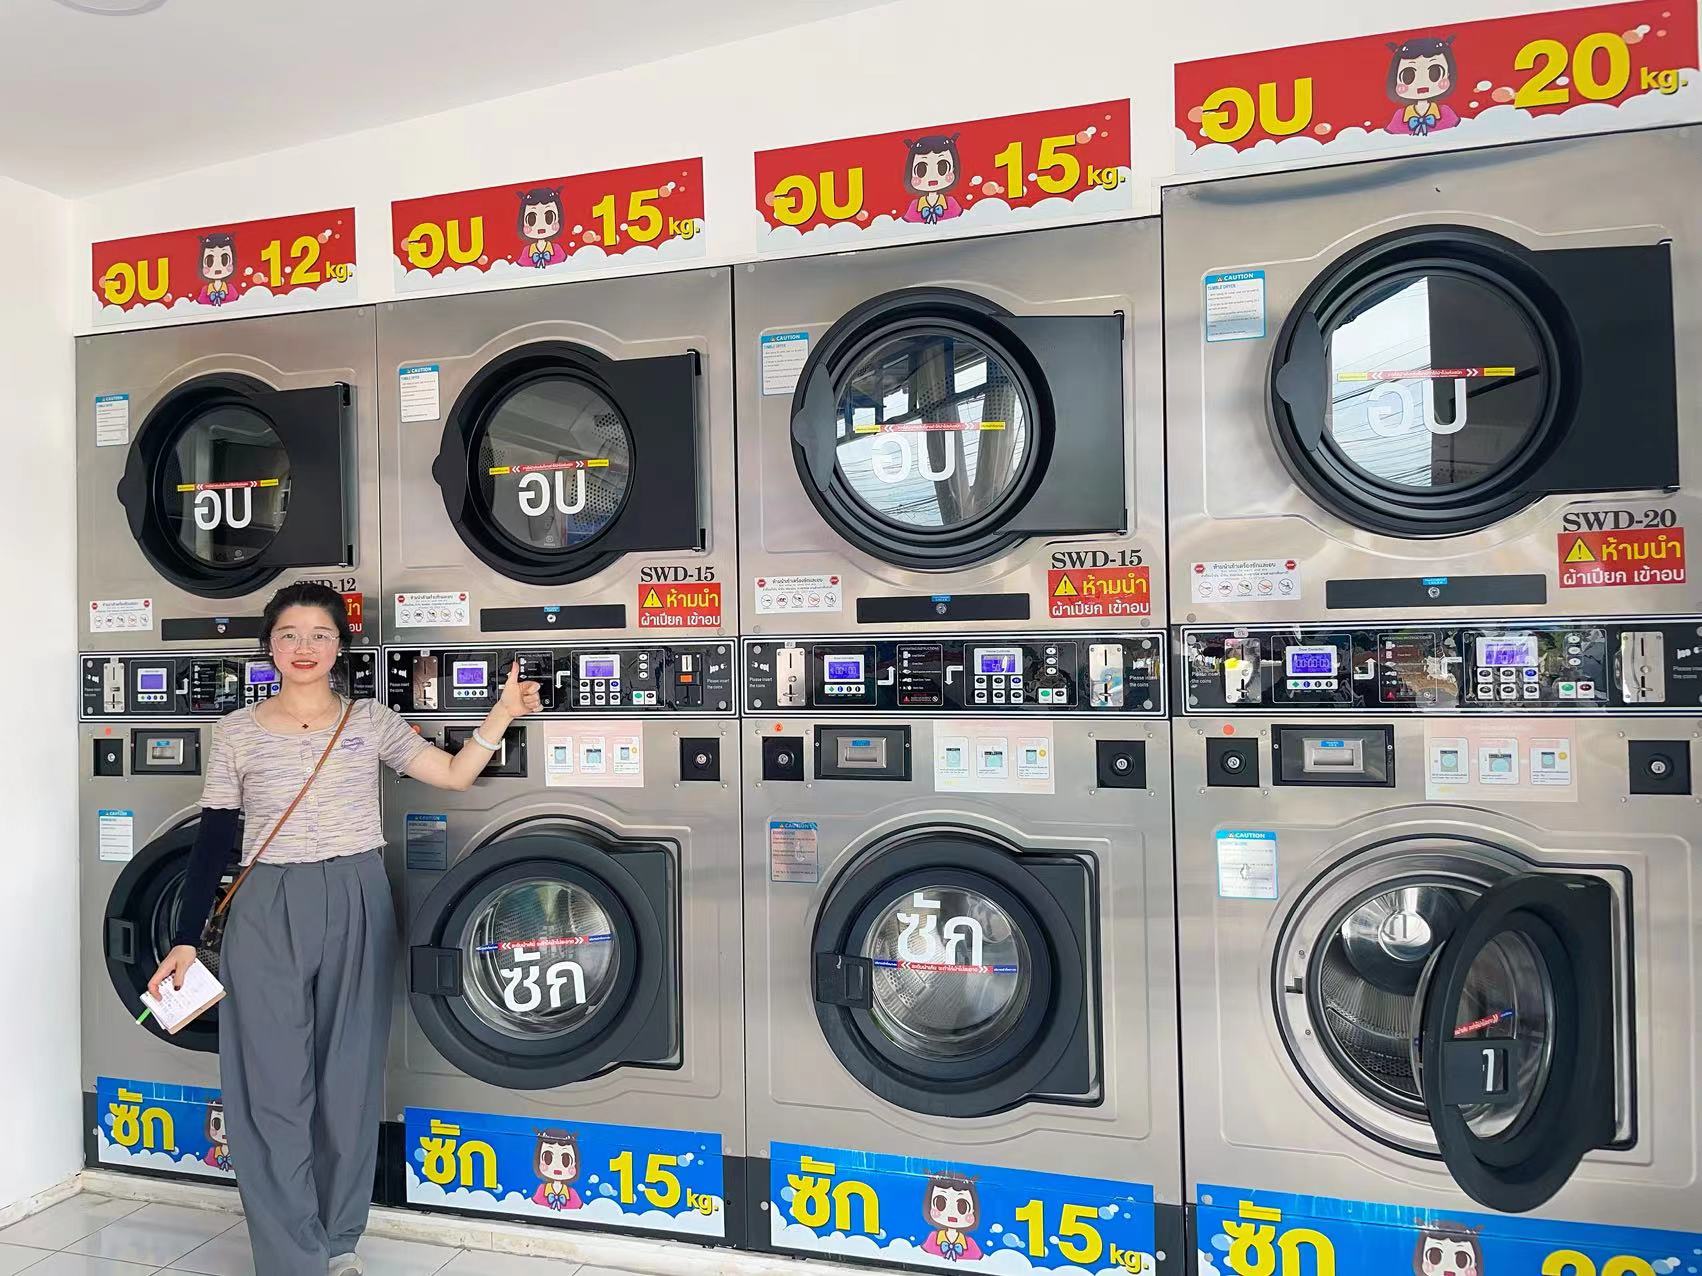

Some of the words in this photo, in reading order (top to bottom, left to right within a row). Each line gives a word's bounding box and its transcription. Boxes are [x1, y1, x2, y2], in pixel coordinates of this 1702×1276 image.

[1200, 78, 1312, 142] อบ
[1514, 33, 1630, 108] 20
[1641, 67, 1687, 93] kg.
[772, 167, 863, 225] อบ
[995, 135, 1080, 198] 15
[1088, 166, 1126, 190] kg.
[406, 217, 484, 269] อบ
[593, 190, 663, 246] 15
[669, 217, 701, 239] kg.
[104, 258, 169, 305] อบ
[260, 236, 320, 287] 12
[326, 261, 353, 281] kg.
[1224, 273, 1254, 281] CAUTION
[1367, 378, 1468, 438] อบ
[872, 431, 956, 484] อบ
[194, 487, 253, 531] อบ
[518, 468, 586, 517] อบ
[1562, 509, 1677, 532] SWD-20
[1051, 549, 1143, 569] SWD-15
[1601, 535, 1681, 560] ห้ามนำ
[640, 566, 715, 582] SWD-15
[666, 588, 719, 608] ห้ามนำ
[1082, 573, 1147, 595] ห้ามนำ
[1563, 568, 1627, 584] ผ้าเปียก
[1634, 565, 1684, 582] เข้าอบ
[641, 611, 683, 625] ผ้าเปียก
[687, 611, 720, 626] เข้าอบ
[1052, 601, 1103, 616] ผ้าเปียก
[1108, 600, 1149, 614] เข้าอบ
[897, 892, 983, 965] ซัก
[500, 947, 586, 1012] ซัก
[109, 1088, 174, 1151] ซัก
[420, 1119, 497, 1188] ซัก
[610, 1151, 680, 1208] 15
[687, 1188, 719, 1214] kg.
[787, 1156, 879, 1233] ซัก
[1015, 1200, 1102, 1263] 15
[1110, 1243, 1150, 1274] kg.
[1222, 1200, 1336, 1276] ซัก
